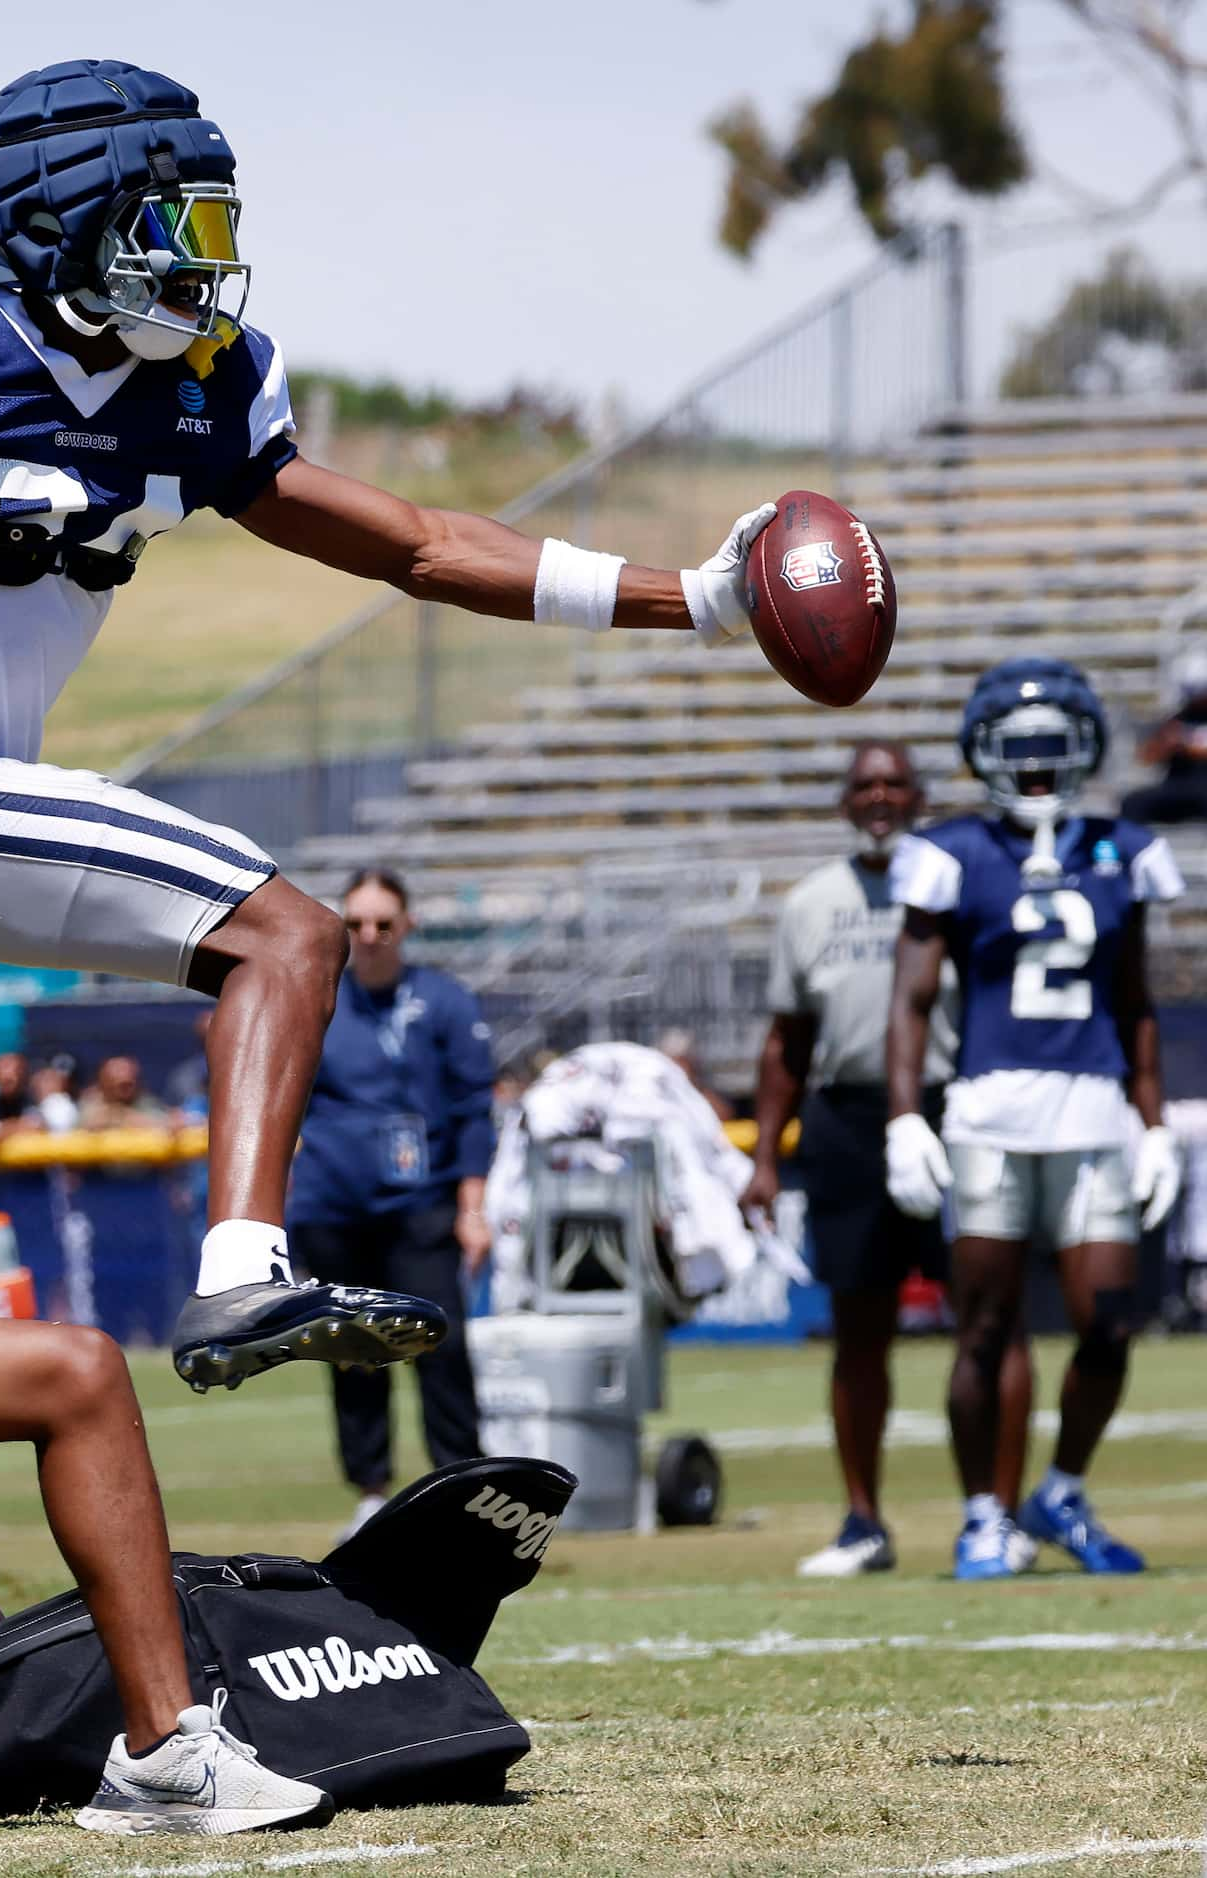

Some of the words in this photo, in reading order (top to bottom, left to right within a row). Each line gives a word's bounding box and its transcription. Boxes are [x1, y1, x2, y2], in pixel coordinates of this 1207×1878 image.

[54, 431, 119, 451] COWBOYS
[175, 416, 214, 435] AT&T
[1009, 889, 1098, 1021] 2
[248, 1636, 441, 1703] Wilson
